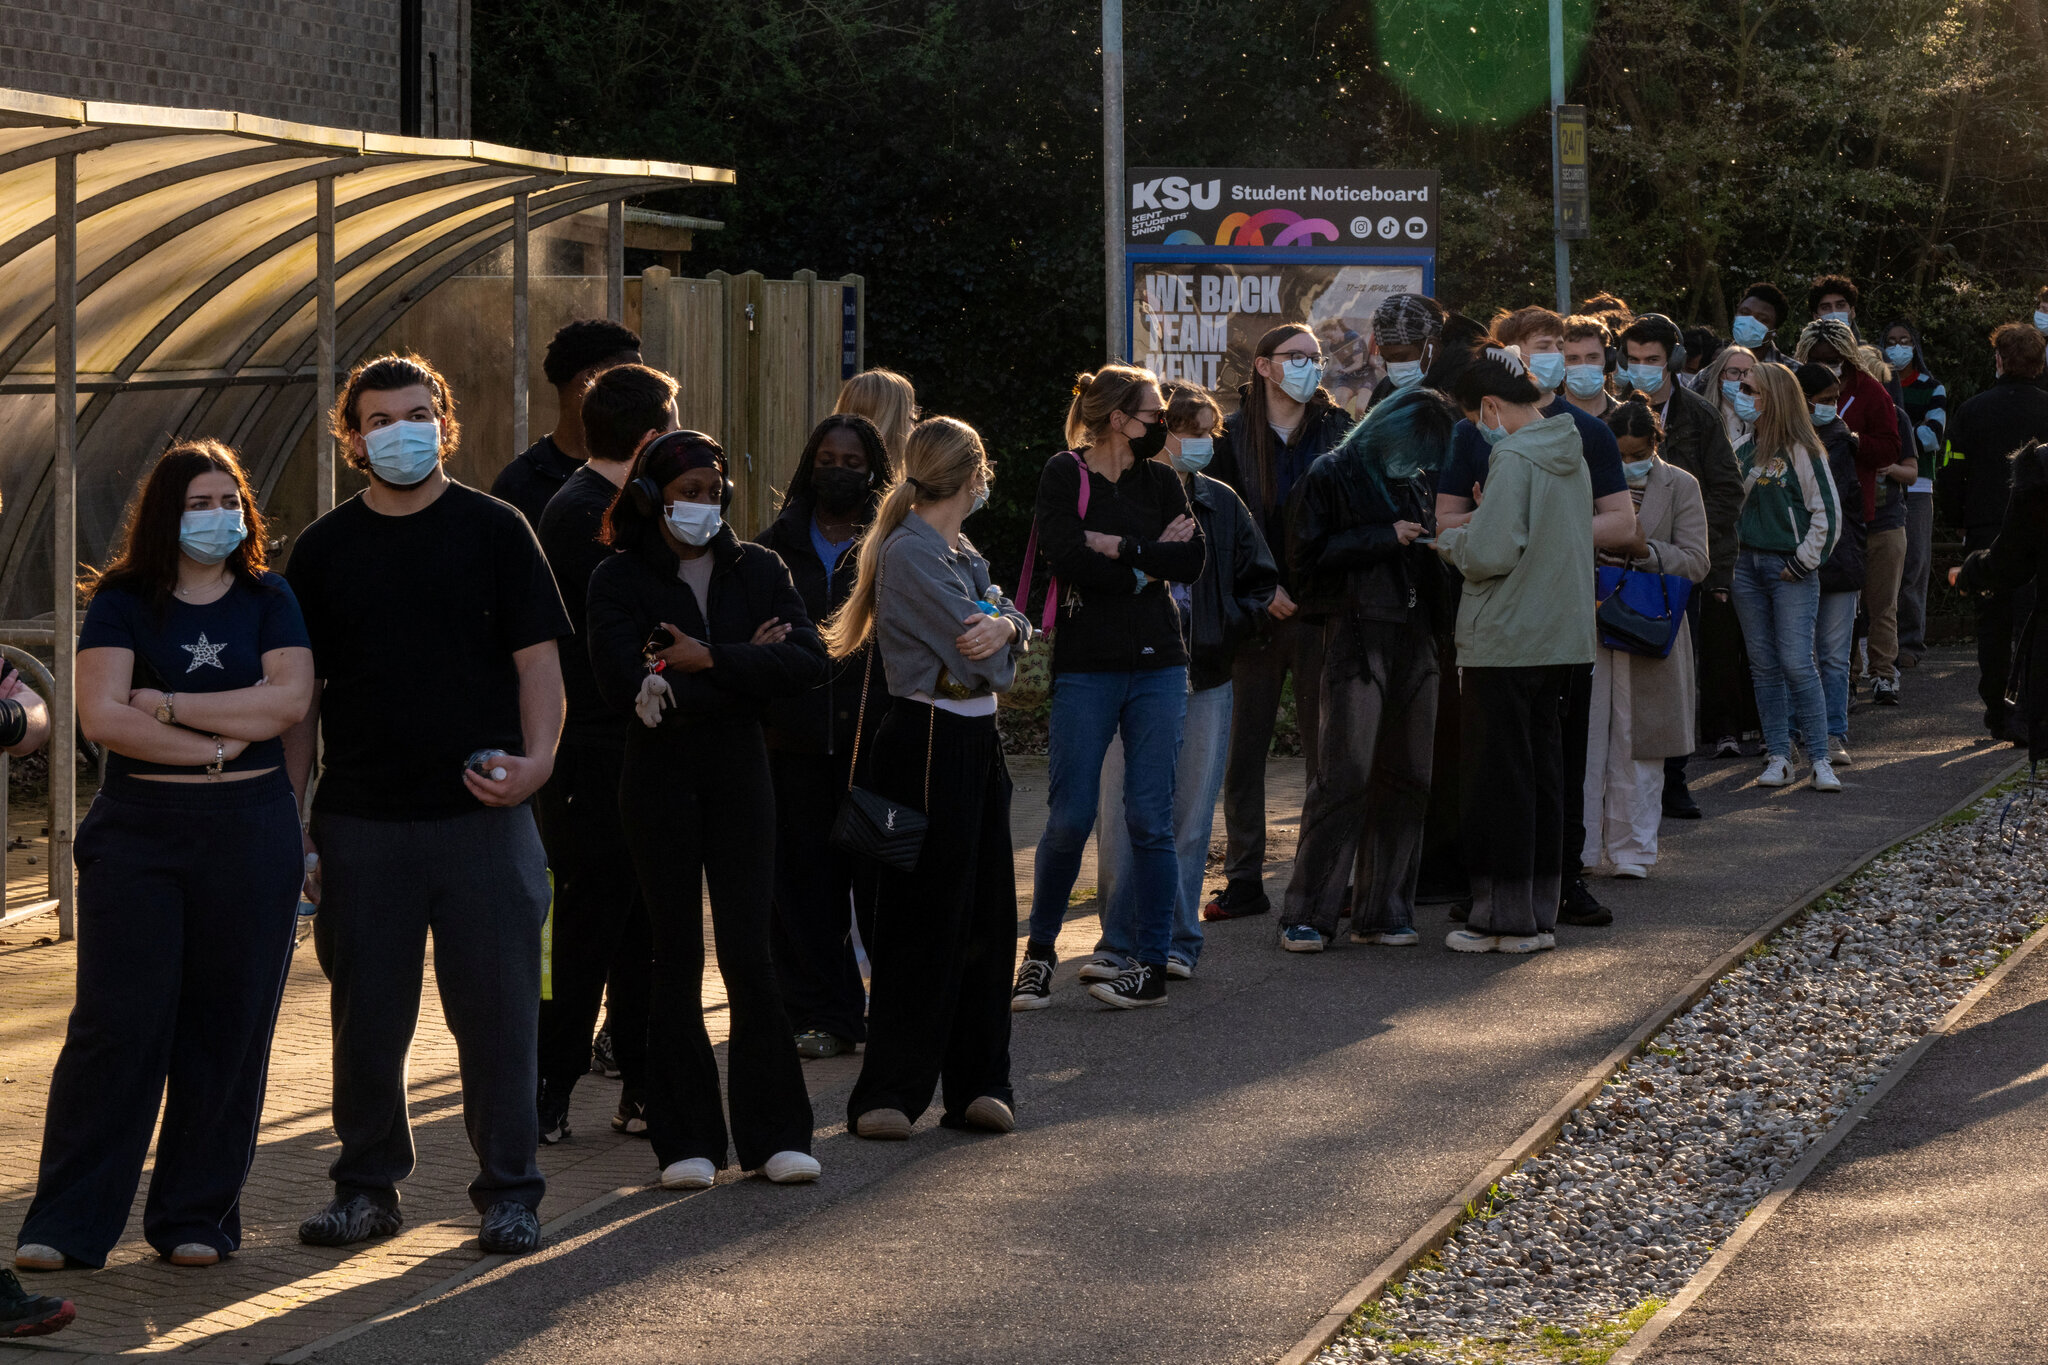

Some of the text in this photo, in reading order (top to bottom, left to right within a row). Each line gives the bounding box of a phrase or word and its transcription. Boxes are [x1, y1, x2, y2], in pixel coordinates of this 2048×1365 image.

[1132, 176, 1221, 210] KSU
[1231, 184, 1429, 202] Student Noticeboard
[1132, 210, 1162, 223] KENT
[1132, 223, 1165, 237] UNION
[1145, 275, 1282, 313] WE BACK
[1145, 314, 1228, 352] TEAM
[1145, 353, 1221, 391] KENT
